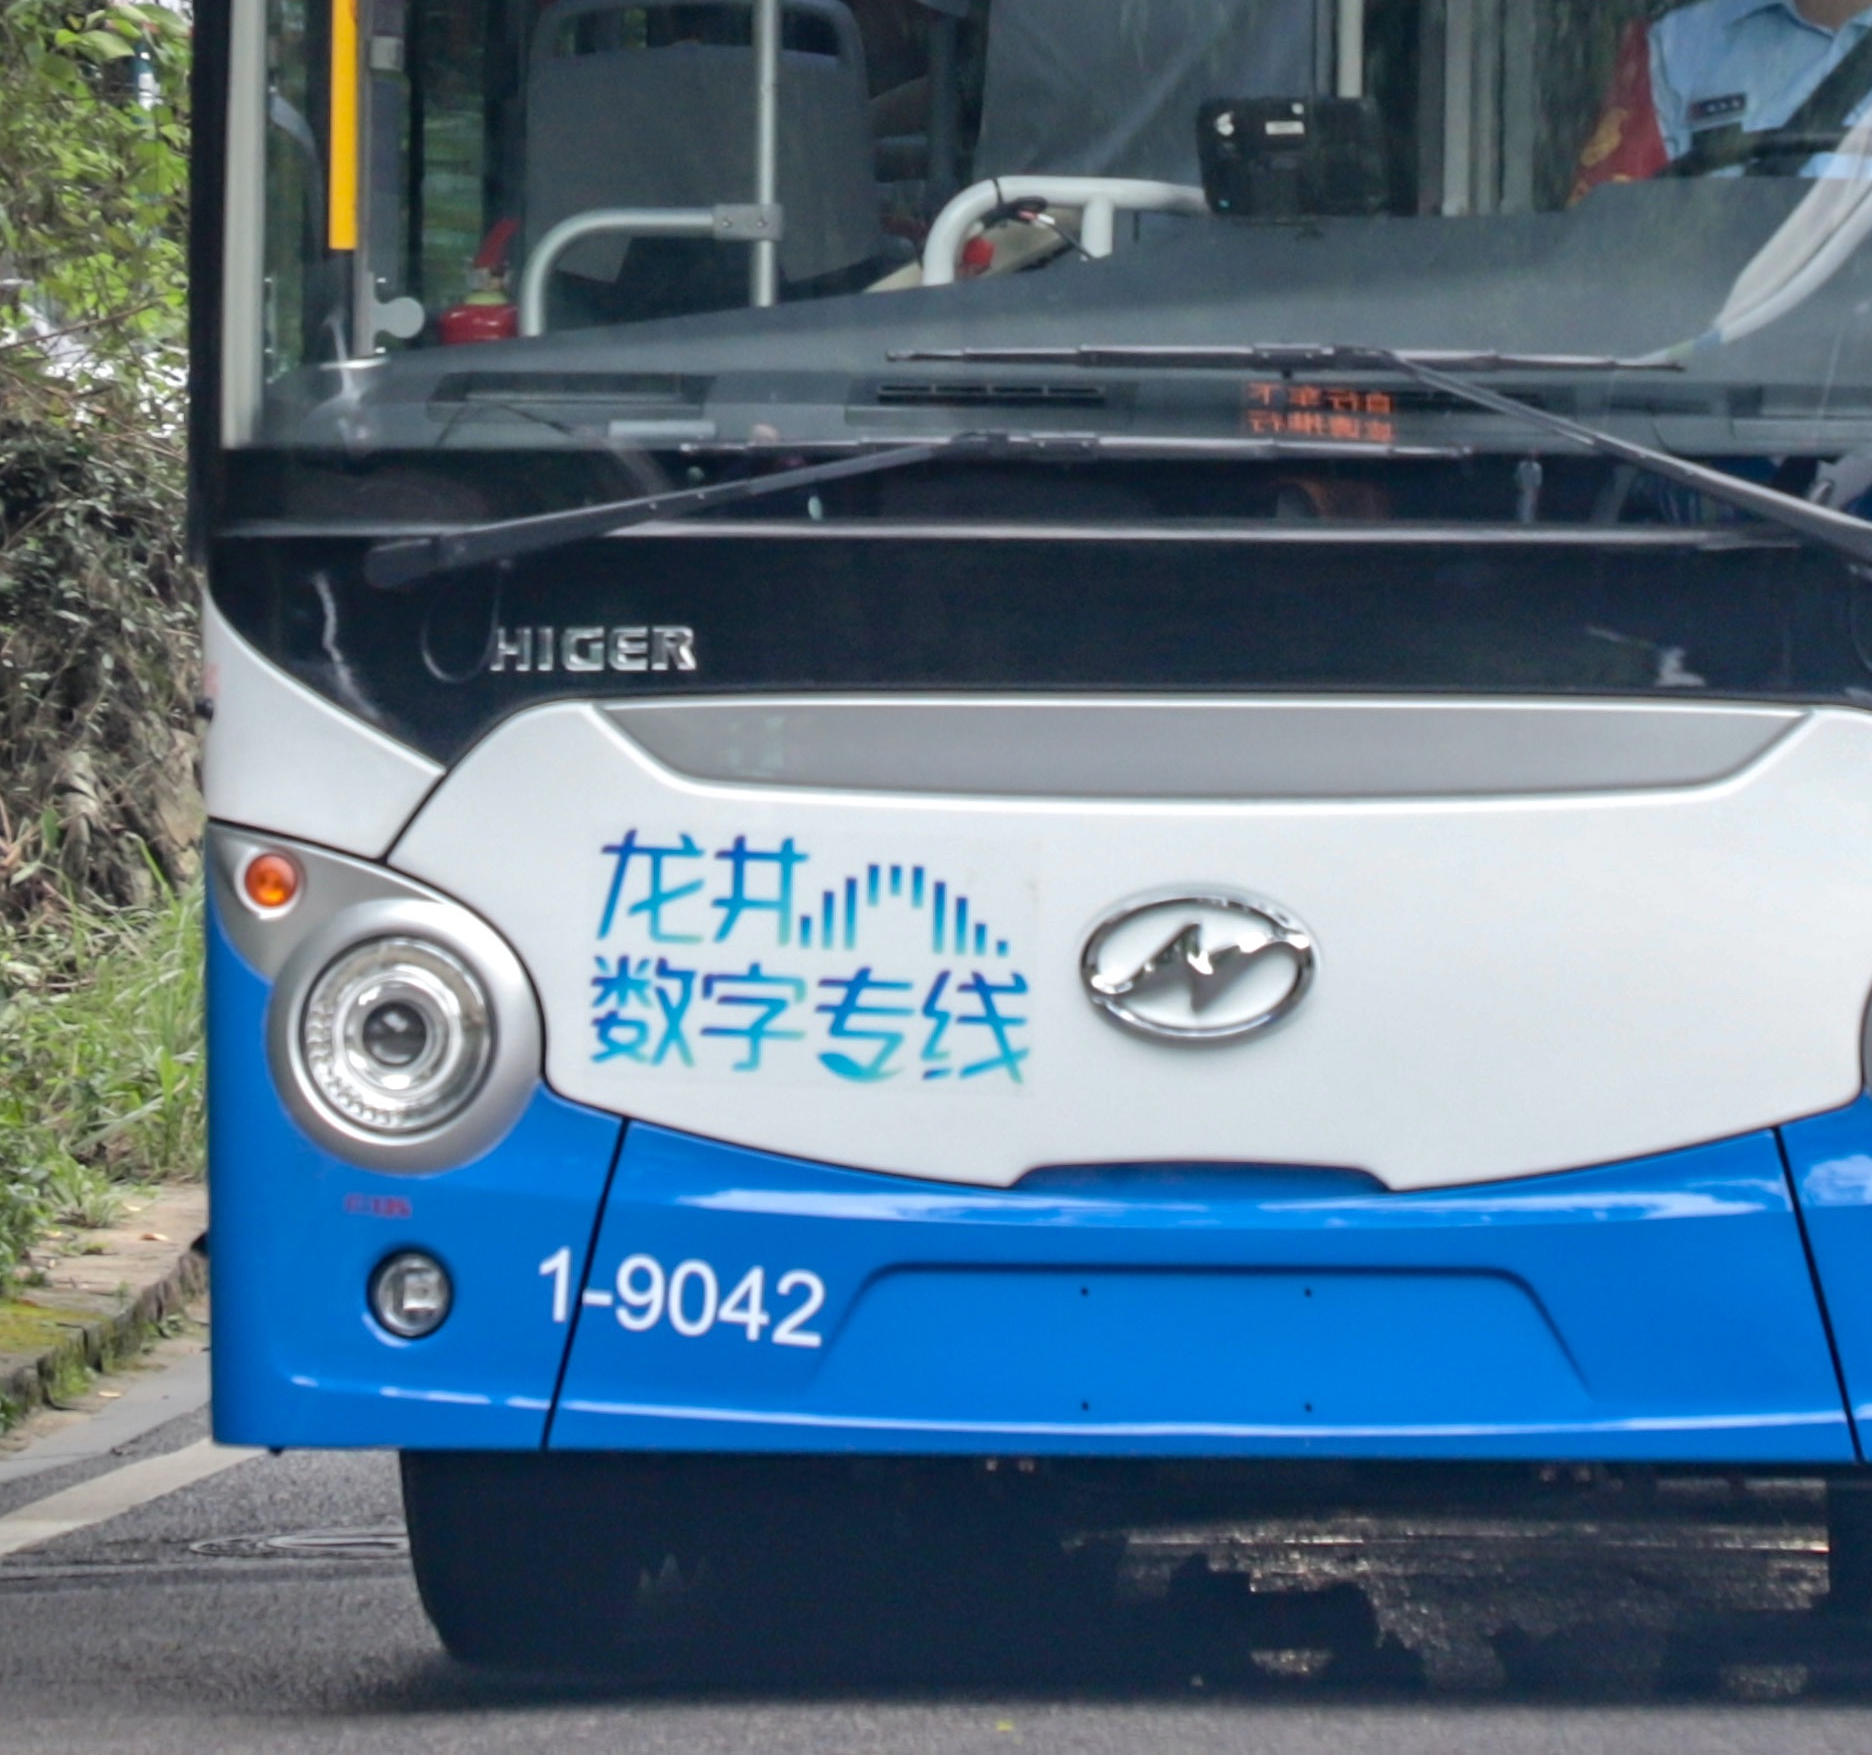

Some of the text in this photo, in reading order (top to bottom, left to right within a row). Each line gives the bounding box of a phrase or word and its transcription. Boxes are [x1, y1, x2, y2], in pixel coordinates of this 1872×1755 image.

[490, 625, 696, 673] HIGER
[596, 828, 810, 947] 龙井
[588, 955, 1030, 1085] 数字专线
[538, 1248, 827, 1348] 1-9042
